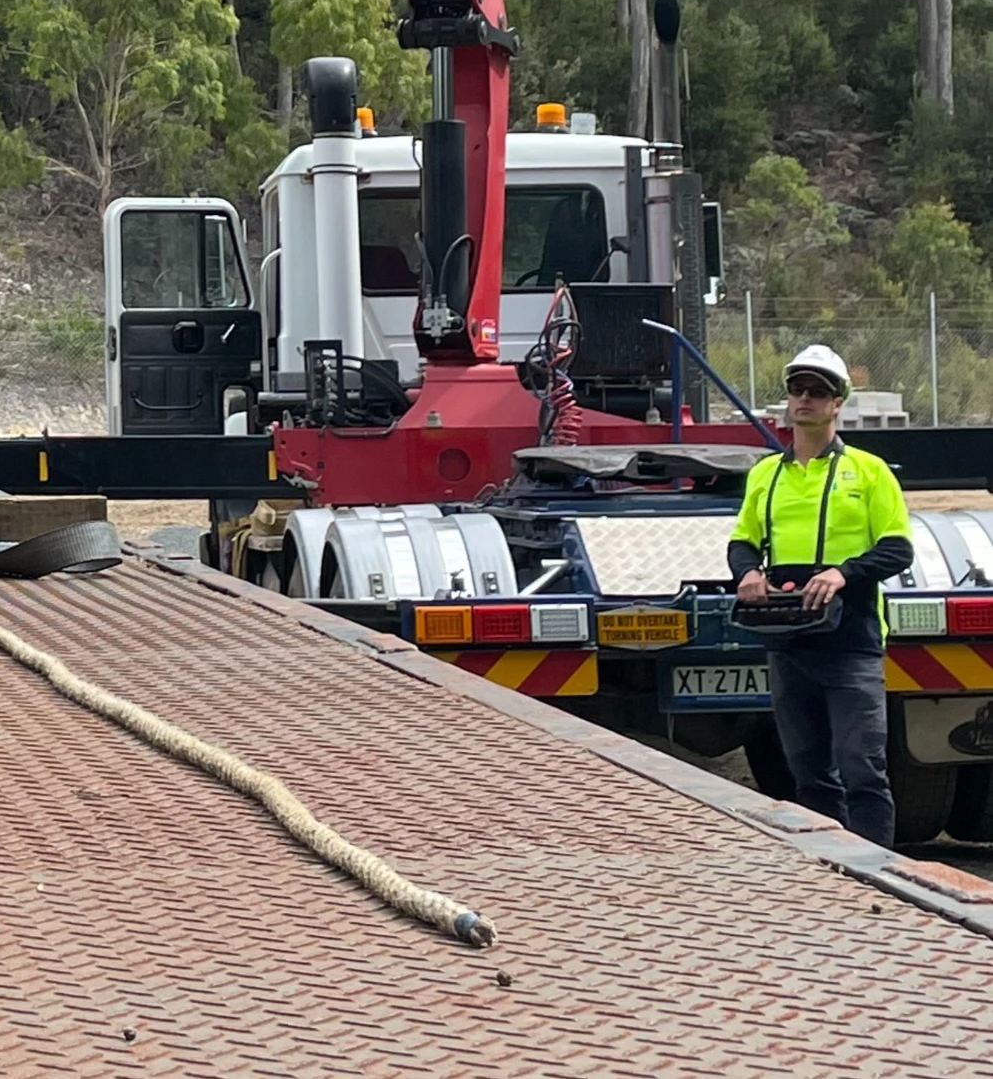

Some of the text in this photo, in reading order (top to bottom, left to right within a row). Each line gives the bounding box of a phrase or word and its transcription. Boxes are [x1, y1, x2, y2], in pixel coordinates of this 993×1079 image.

[603, 614, 678, 627] DO NOT OVERTAKE
[605, 629, 678, 641] TURNING VEHICLE
